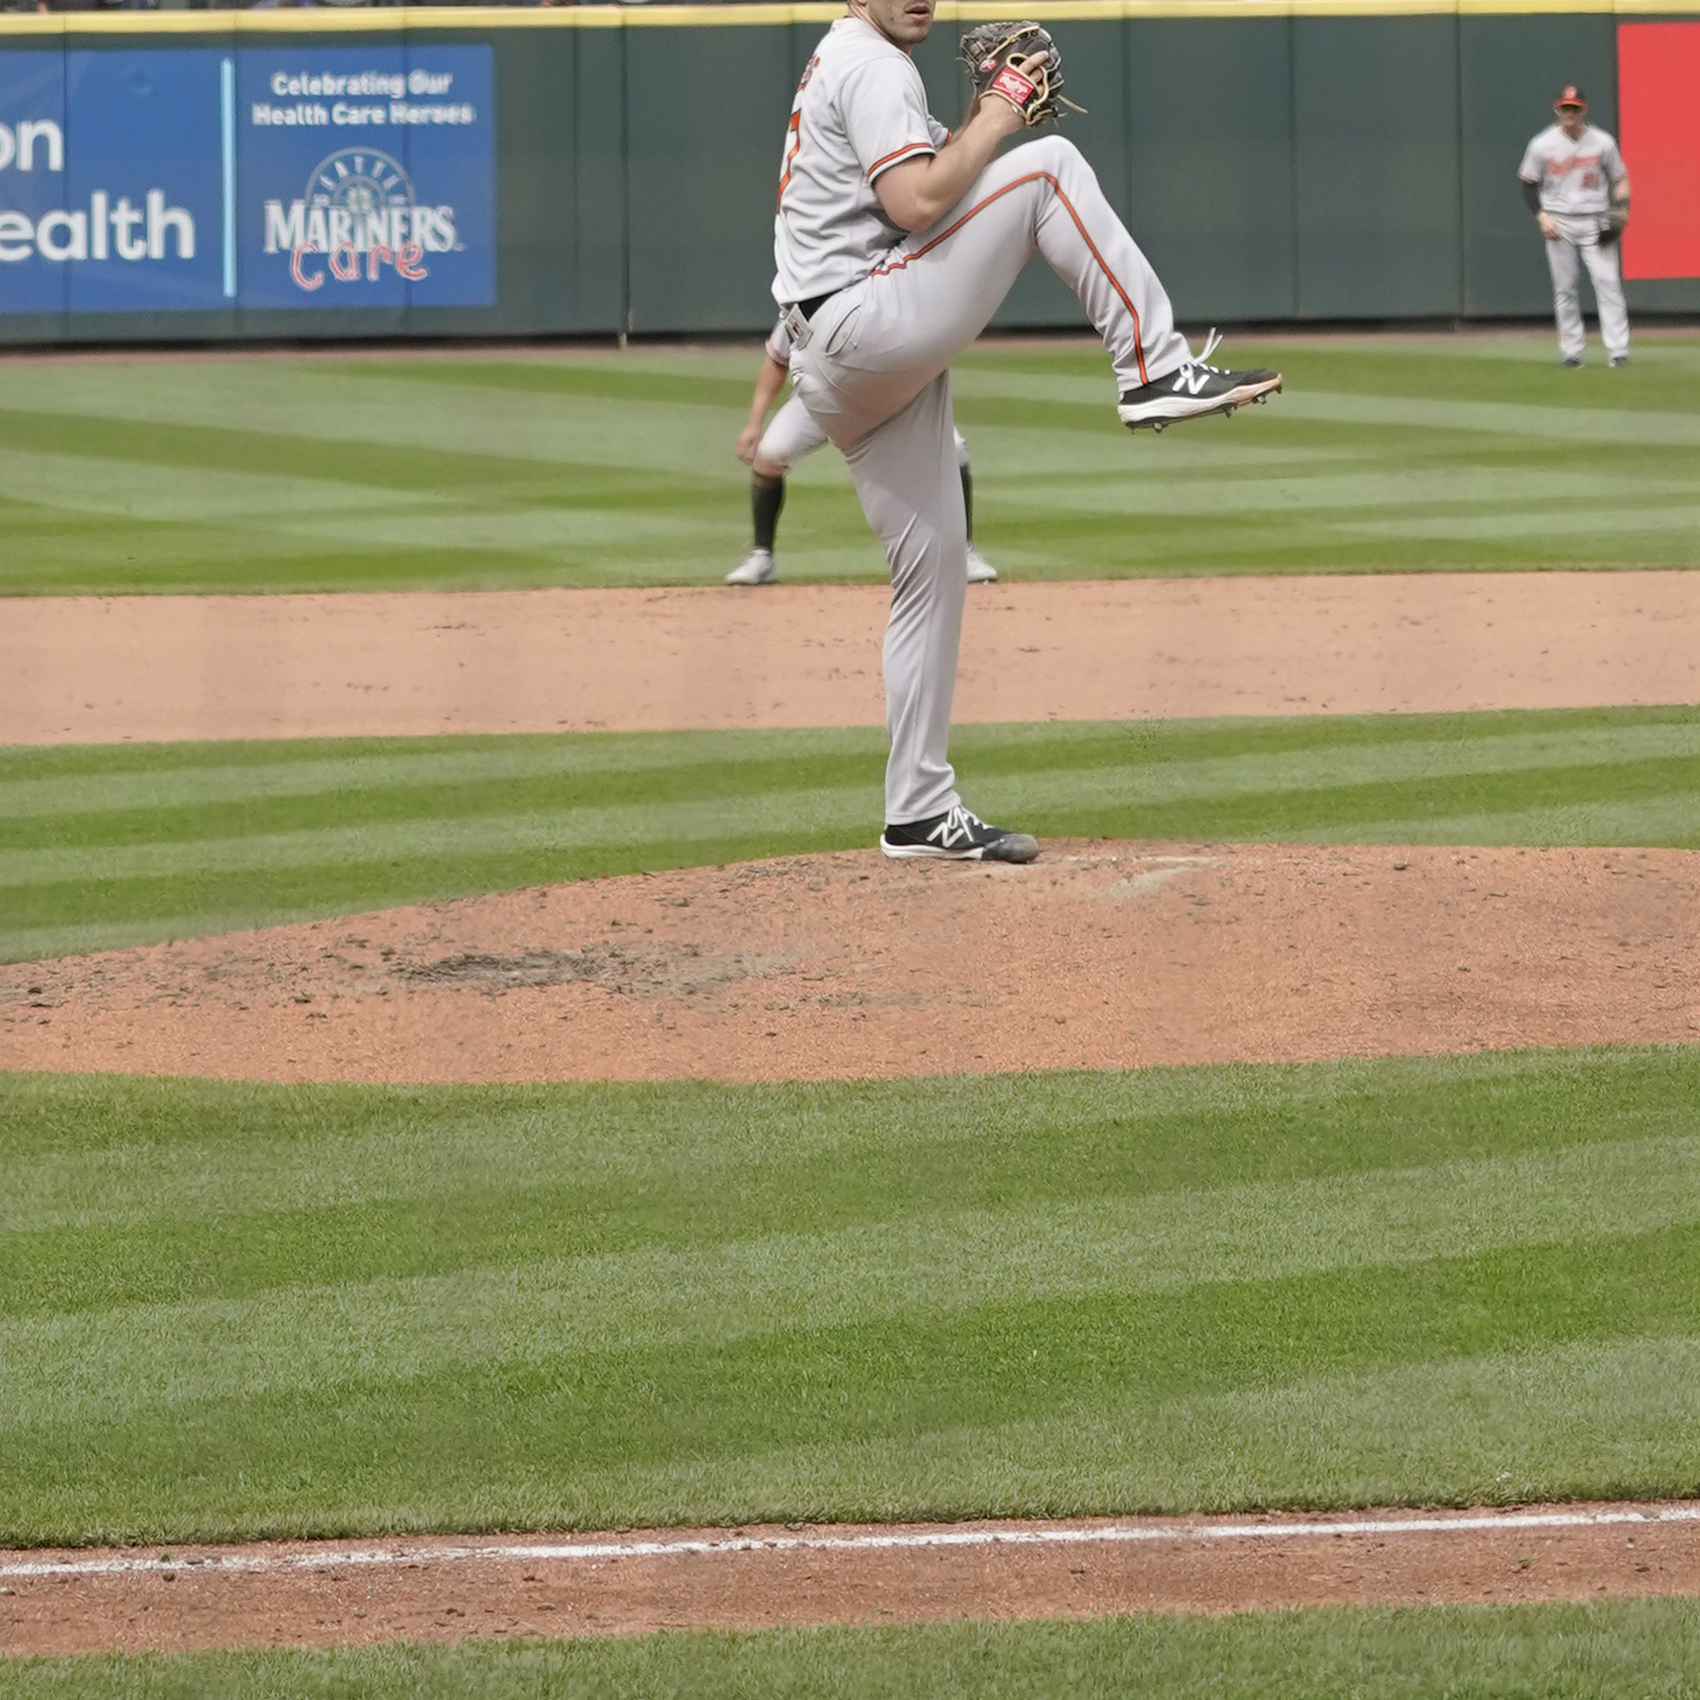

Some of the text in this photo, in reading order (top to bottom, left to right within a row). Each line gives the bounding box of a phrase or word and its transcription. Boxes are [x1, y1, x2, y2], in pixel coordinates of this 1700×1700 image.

[271, 69, 453, 99] Celebrating Our
[252, 102, 474, 126] Health Care Heroes
[264, 199, 457, 254] MARINERS
